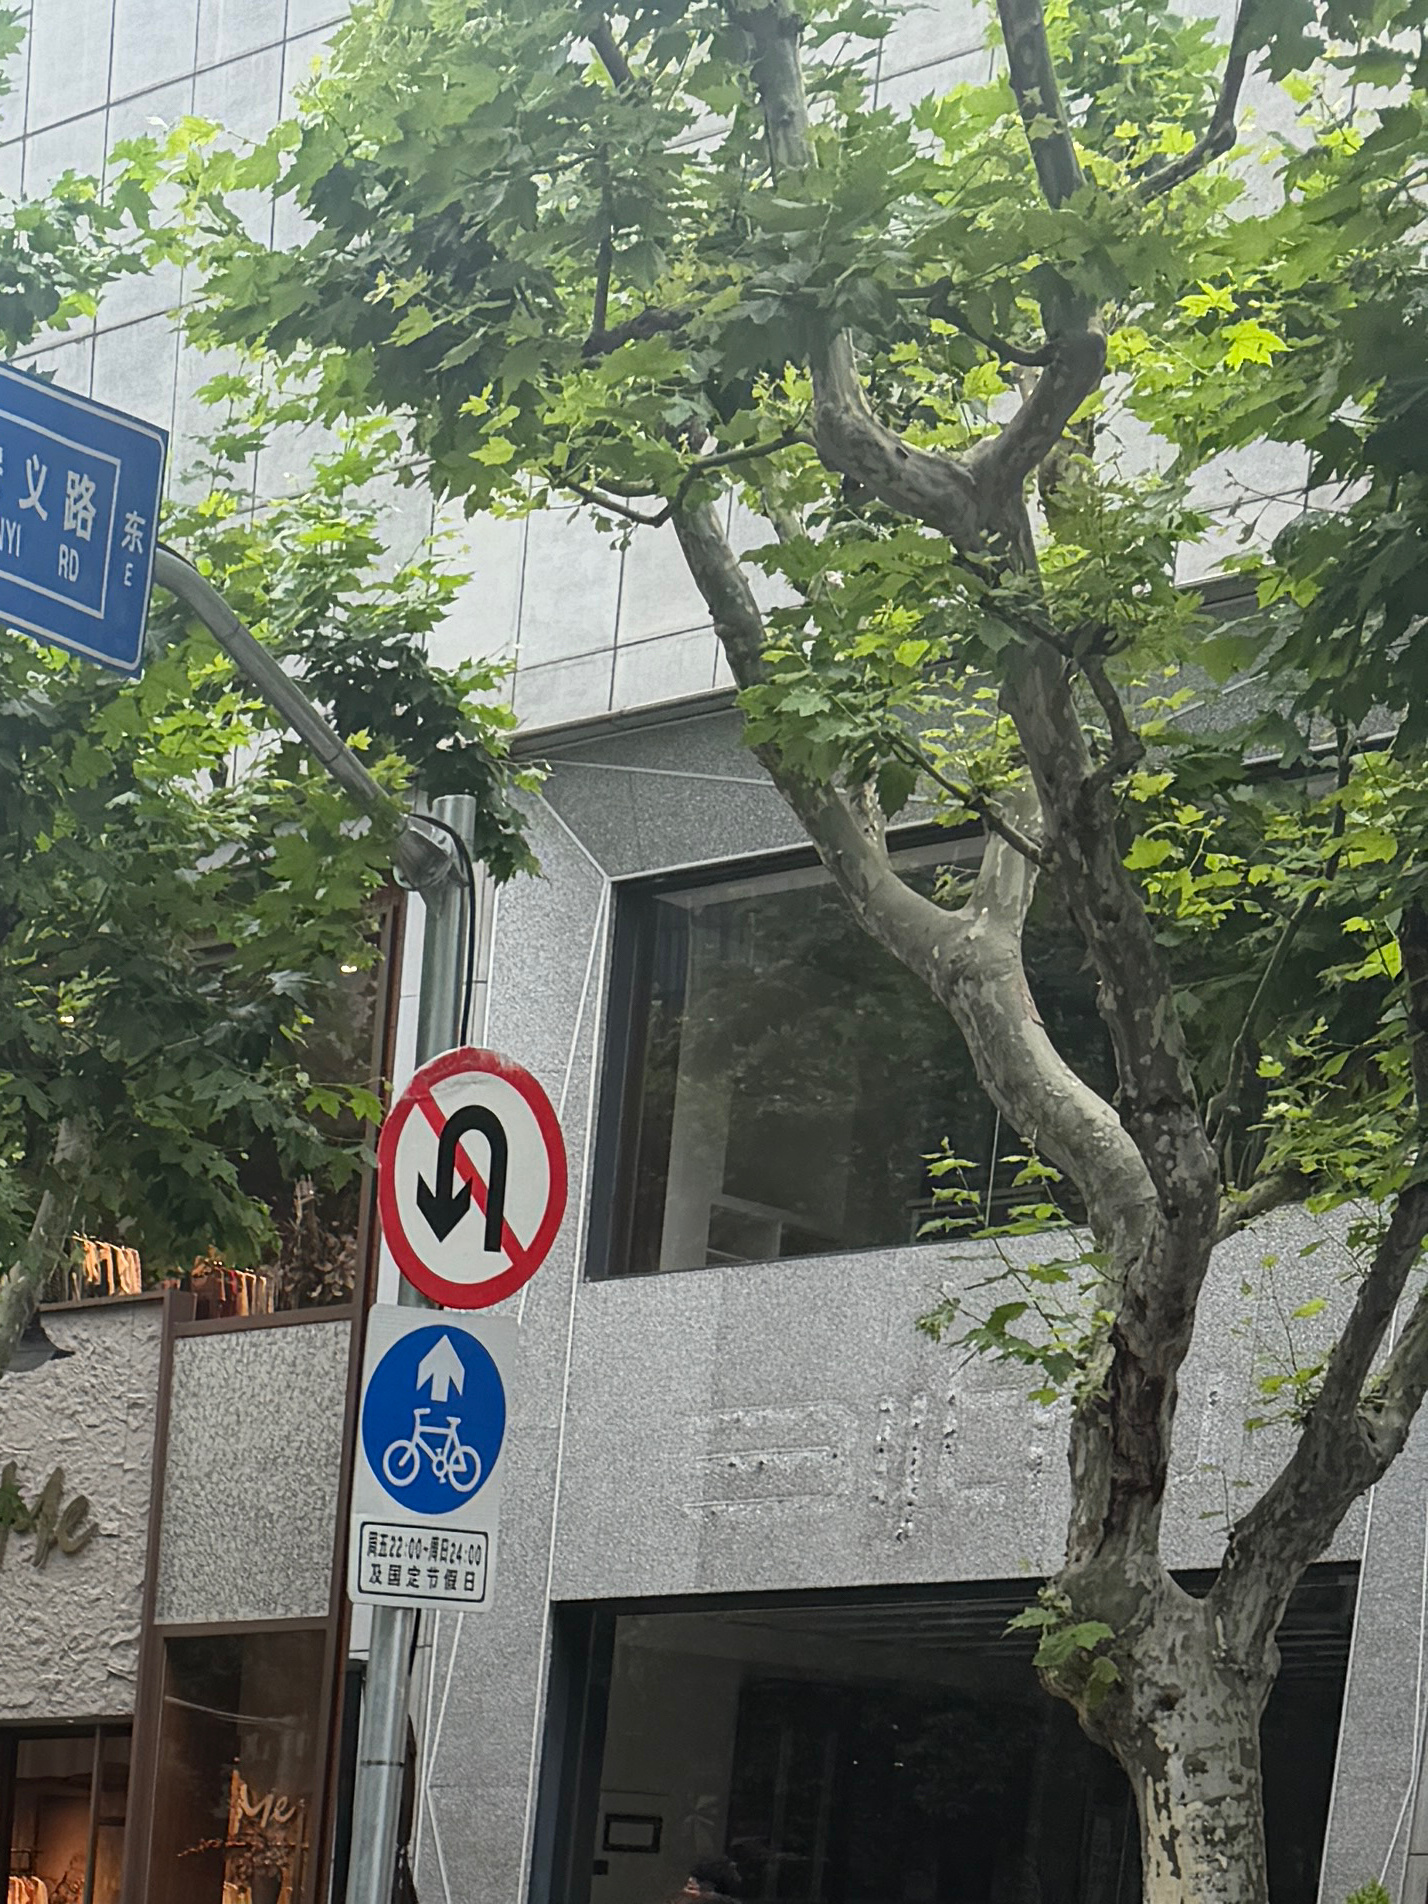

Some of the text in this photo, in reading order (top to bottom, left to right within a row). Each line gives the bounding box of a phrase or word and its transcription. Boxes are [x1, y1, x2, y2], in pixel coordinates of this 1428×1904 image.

[120, 510, 146, 554] 东
[58, 543, 80, 583] RD
[123, 562, 134, 587] E
[369, 1563, 475, 1591] 及国定节假日
